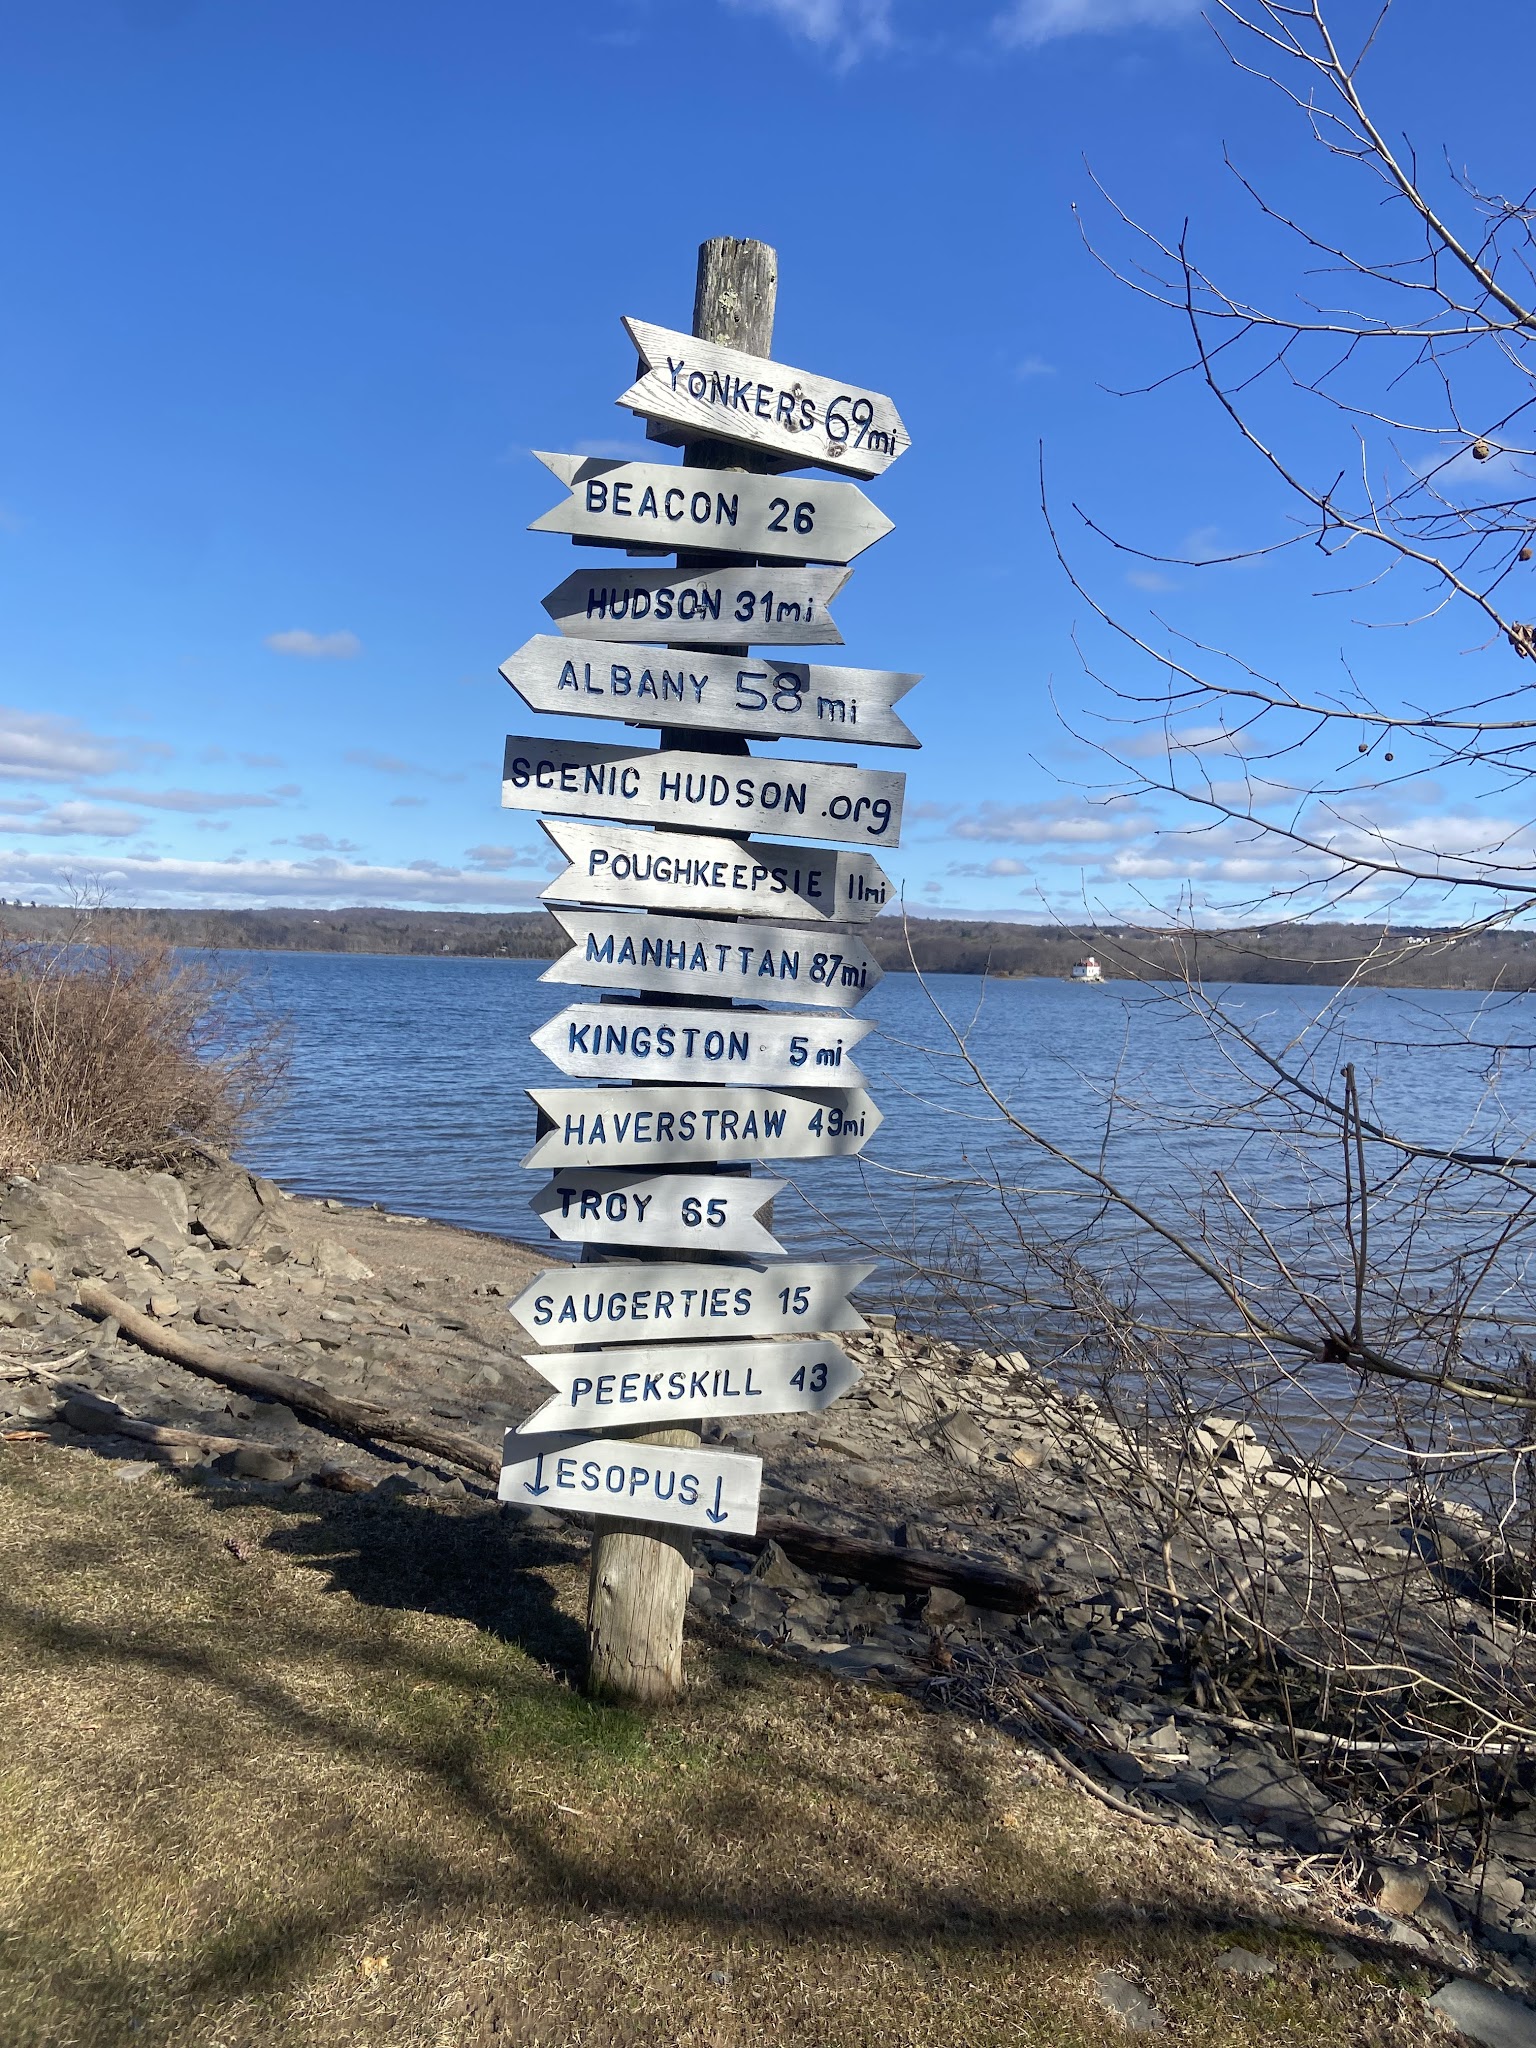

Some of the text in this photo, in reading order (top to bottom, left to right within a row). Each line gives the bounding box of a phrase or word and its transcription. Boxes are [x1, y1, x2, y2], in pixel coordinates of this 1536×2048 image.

[666, 356, 816, 431] YONKERS
[586, 480, 816, 535] BEACON 26
[586, 588, 721, 620] HUDSON
[557, 660, 858, 724] ALBANY 58 mi
[511, 758, 892, 834] SCENIC HUDSON .org
[588, 849, 823, 898] POUGHKEEPSIE
[585, 932, 799, 980] MANHATTAN
[568, 1022, 844, 1067] KINGSTON 5 mi
[564, 1108, 787, 1146] HAVERSTRAW
[556, 1188, 729, 1228] TROY 65
[533, 1286, 812, 1325] SAUGERTIES 15
[570, 1362, 829, 1407] PEEKSKILL 43
[556, 1458, 700, 1506] ESOPUS
